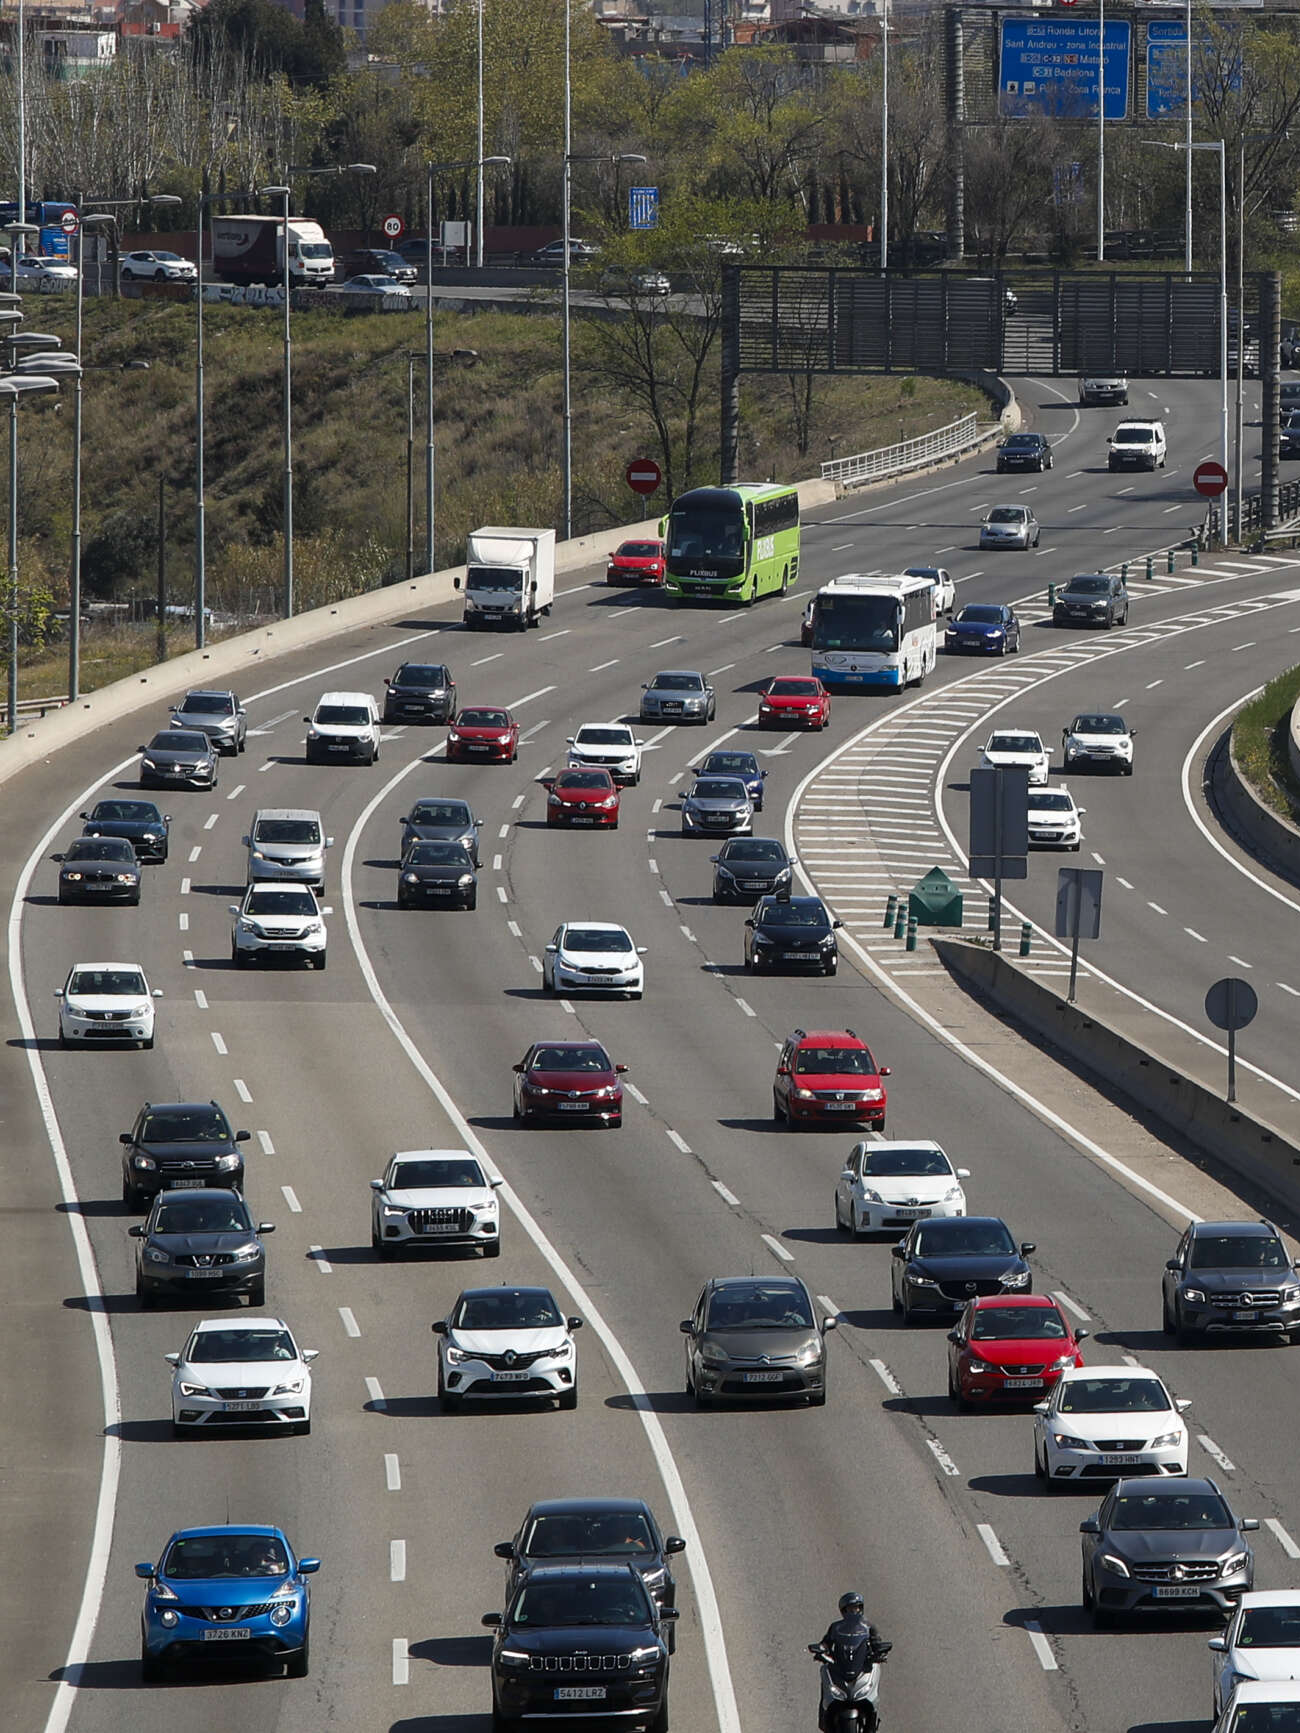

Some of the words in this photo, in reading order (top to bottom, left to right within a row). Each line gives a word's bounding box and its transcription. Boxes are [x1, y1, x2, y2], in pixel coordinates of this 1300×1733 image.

[1047, 26, 1075, 35] Ronda
[1079, 26, 1106, 36] Litorl
[1005, 39, 1024, 48] Sant
[1028, 40, 1056, 49] Andreu
[1054, 67, 1095, 77] Badalona
[387, 222, 399, 231] 80
[207, 1630, 229, 1640] 3726
[231, 1629, 249, 1639] KNZ
[559, 1689, 584, 1698] 5412
[585, 1688, 604, 1697] LRZ
